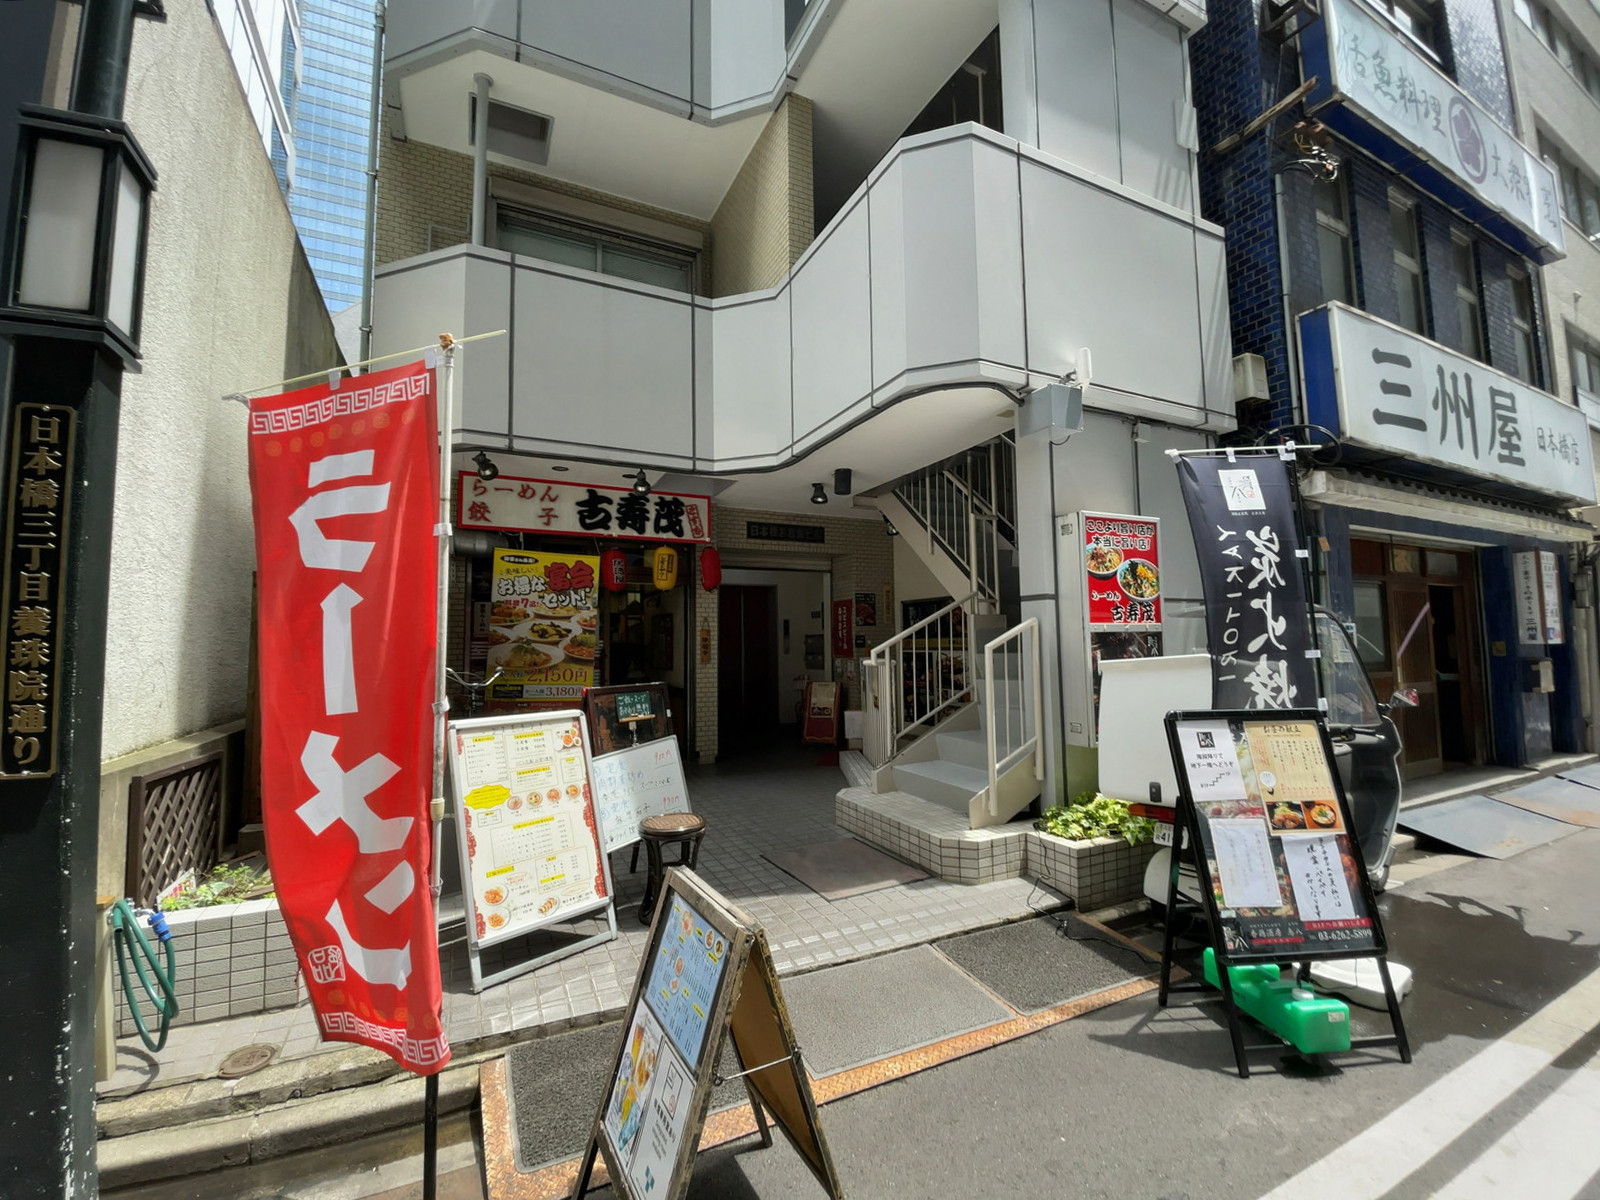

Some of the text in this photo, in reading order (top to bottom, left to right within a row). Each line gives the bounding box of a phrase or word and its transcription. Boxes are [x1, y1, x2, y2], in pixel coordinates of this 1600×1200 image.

[1372, 347, 1526, 467] 三州屋
[1536, 426, 1580, 466] 日本橋店
[472, 479, 559, 502] らーめん
[468, 500, 559, 527] 餃子
[1086, 520, 1154, 536] ここより旨い店が
[8, 415, 62, 765] 日本橋三丁目養珠院通り
[497, 575, 547, 596] お得な
[1091, 590, 1121, 601] らーめん
[526, 667, 588, 684] 2,150円
